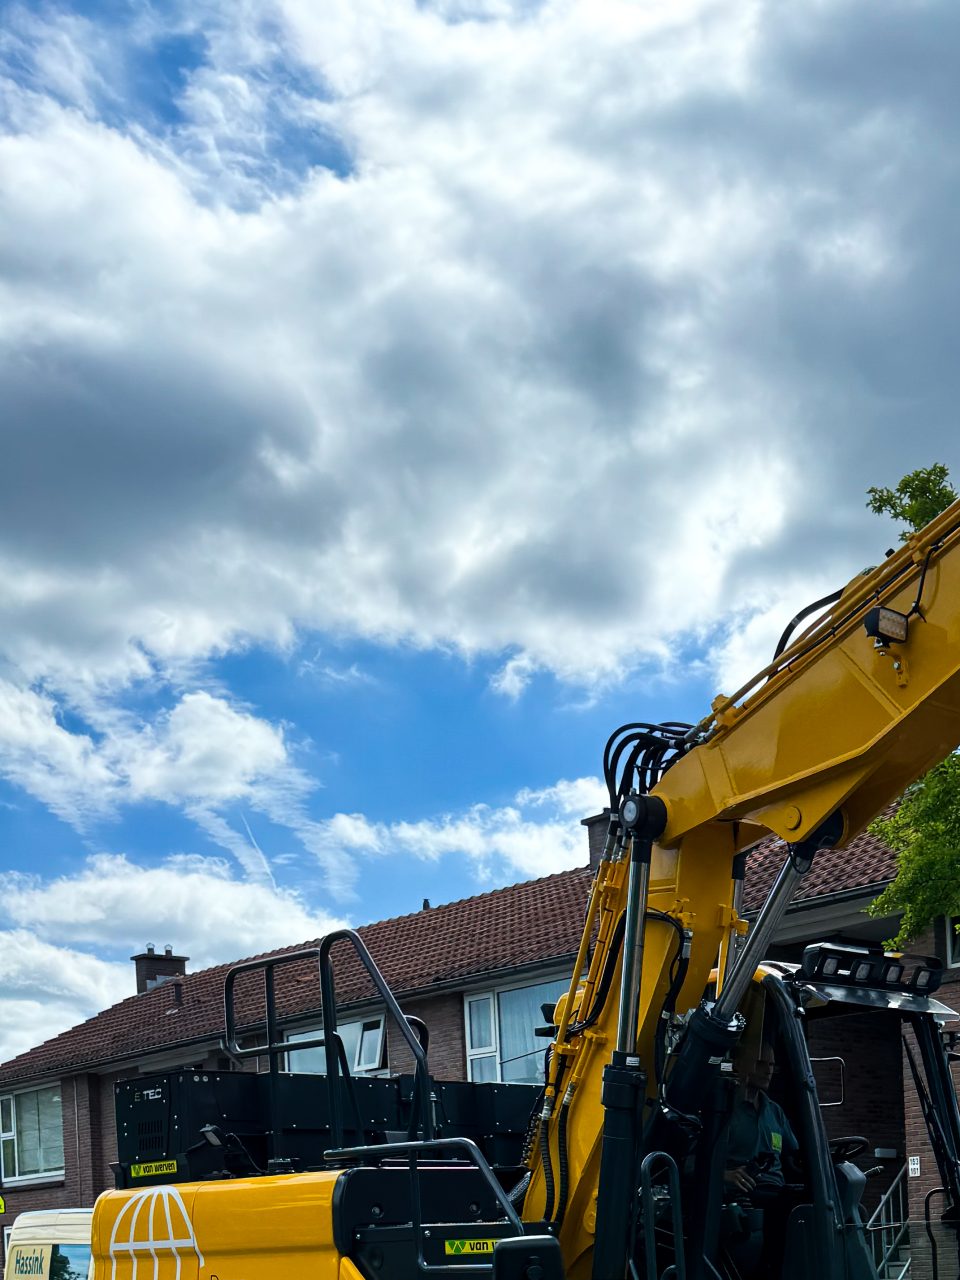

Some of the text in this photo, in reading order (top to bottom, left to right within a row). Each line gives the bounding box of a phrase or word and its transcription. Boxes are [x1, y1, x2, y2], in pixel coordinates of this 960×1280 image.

[143, 1089, 161, 1100] TEC
[155, 1163, 175, 1172] werven
[470, 1242, 488, 1250] van
[15, 1249, 44, 1274] Hassink
